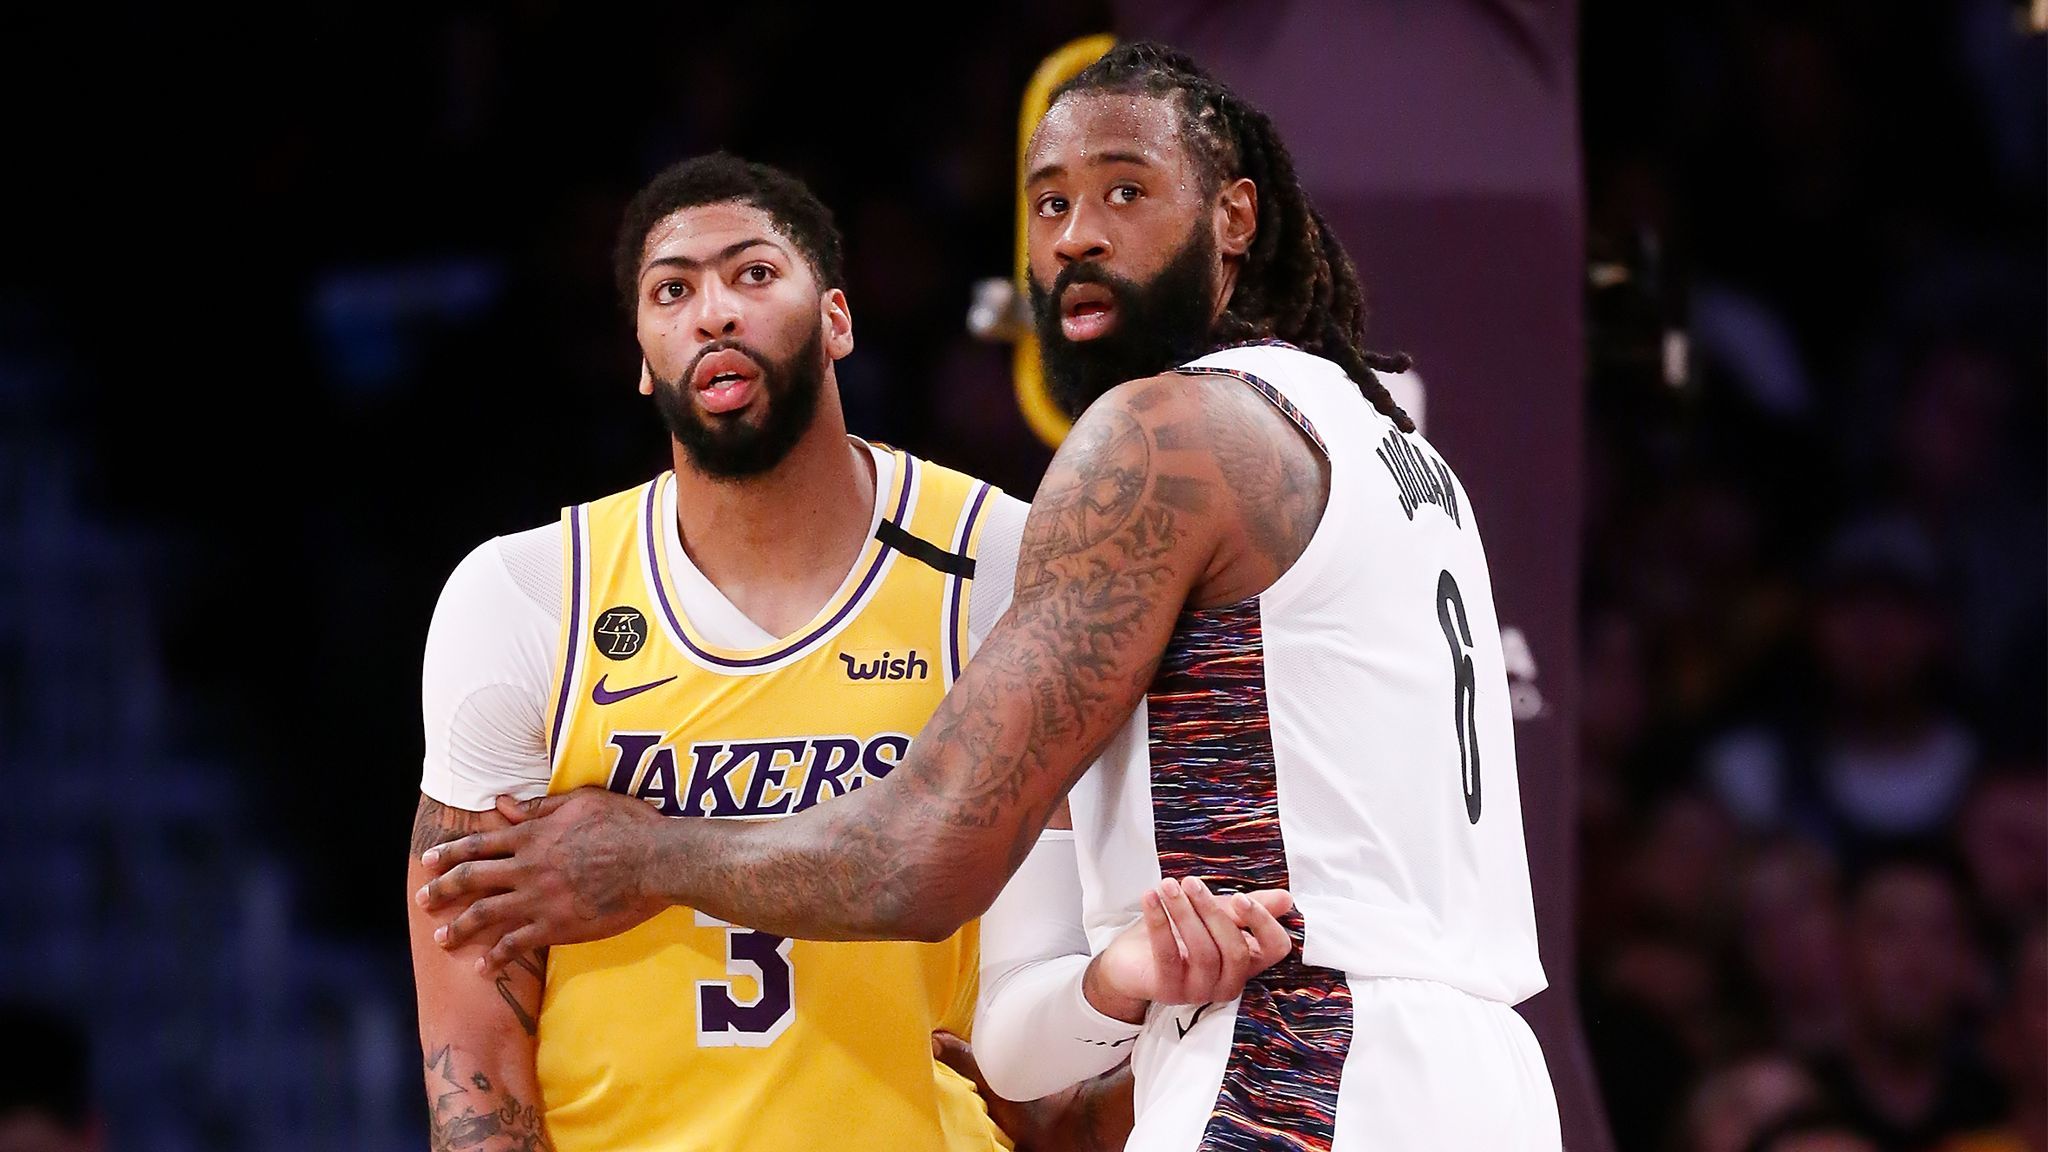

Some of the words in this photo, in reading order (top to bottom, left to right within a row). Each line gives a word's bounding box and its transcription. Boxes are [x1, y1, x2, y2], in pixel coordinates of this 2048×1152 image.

[1375, 428, 1461, 530] JORDAN
[839, 650, 928, 680] wish
[1436, 569, 1481, 825] 6
[695, 910, 797, 1047] 3
